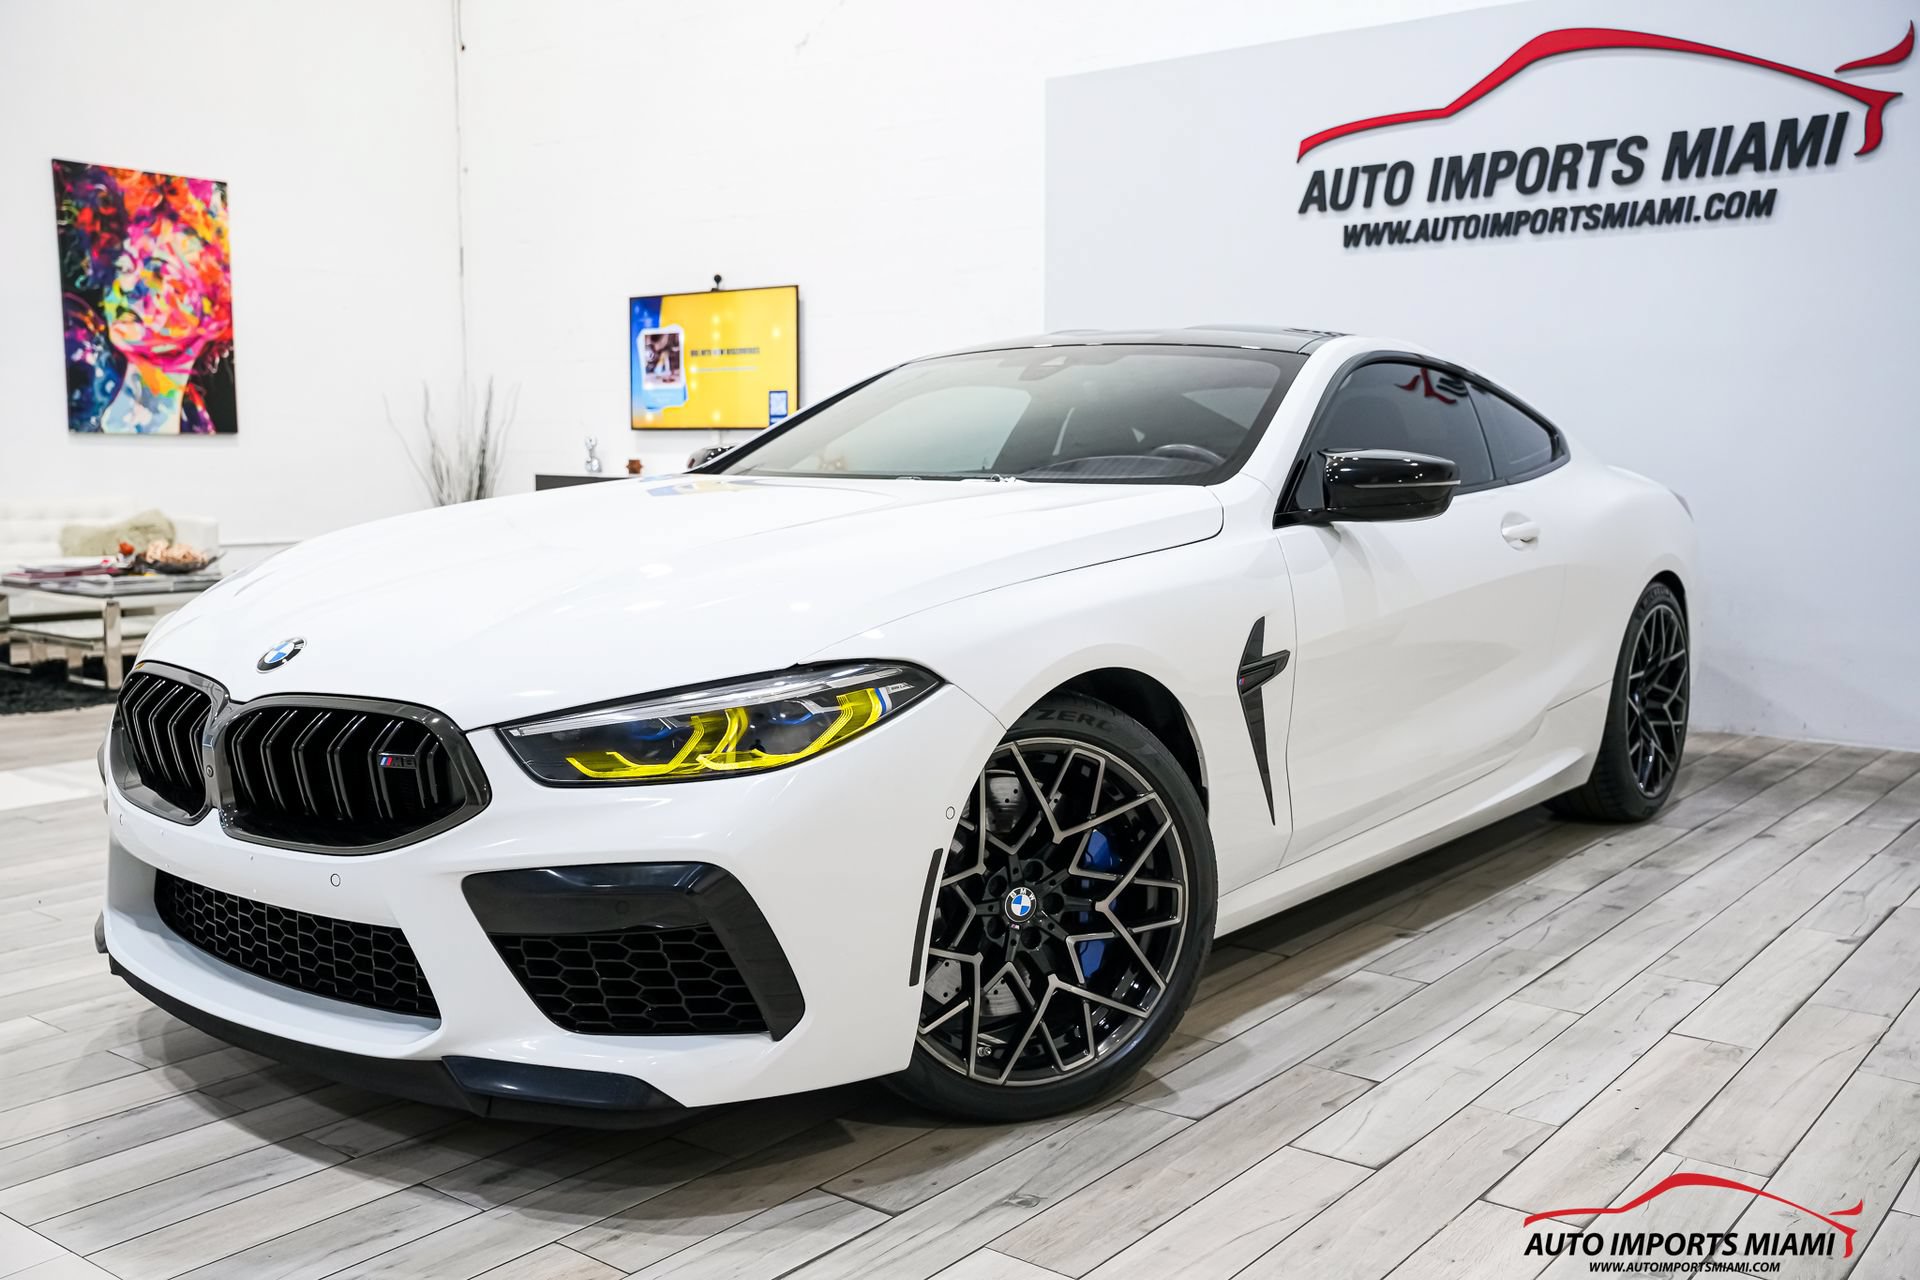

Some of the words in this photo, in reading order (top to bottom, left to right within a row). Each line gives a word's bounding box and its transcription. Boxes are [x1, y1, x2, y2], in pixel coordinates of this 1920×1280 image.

[1298, 160, 1415, 214] AUTO
[1426, 135, 1648, 202] IMPORTS
[1661, 111, 1850, 181] MIAMI
[1342, 188, 1778, 249] WWW.AUTOIMPORTSMIAMI.COM
[1009, 887, 1036, 901] BMW
